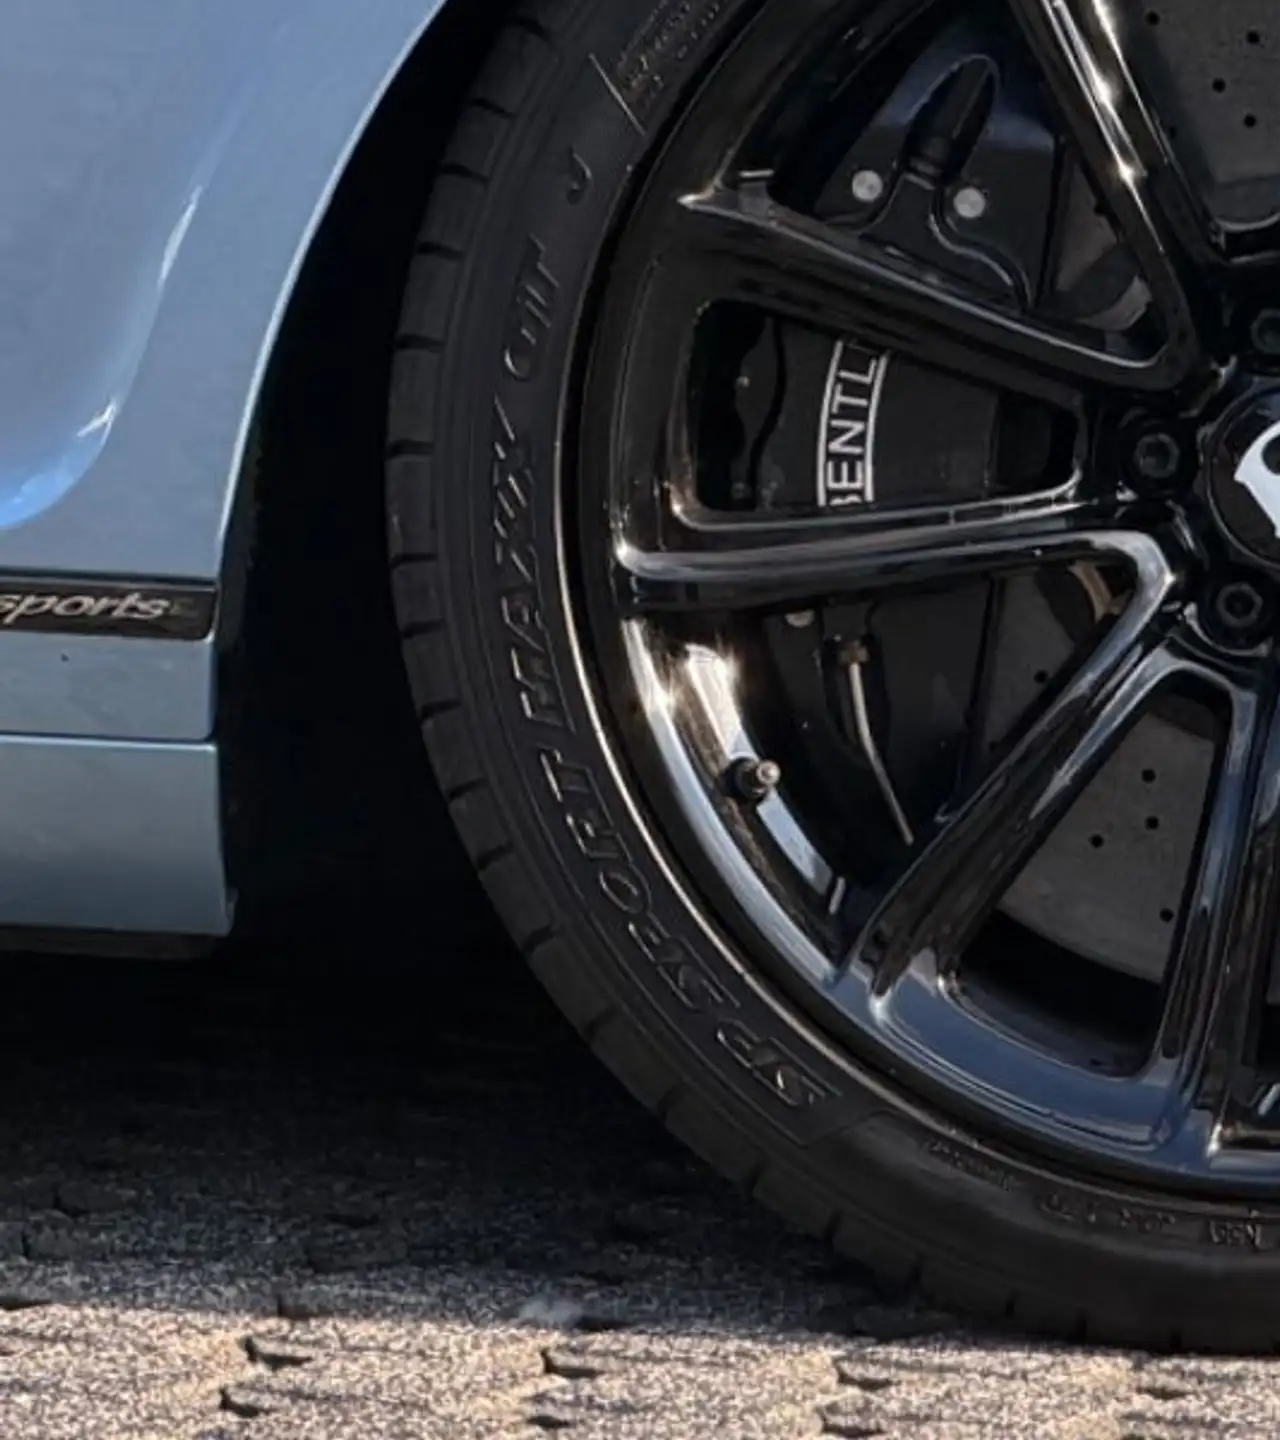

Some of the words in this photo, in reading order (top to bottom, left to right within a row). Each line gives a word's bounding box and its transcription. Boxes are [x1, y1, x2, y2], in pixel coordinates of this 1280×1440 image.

[826, 342, 880, 506] ENTL
[0, 592, 171, 625] sports
[539, 747, 740, 1008] SPORT
[715, 1019, 843, 1106] SP
